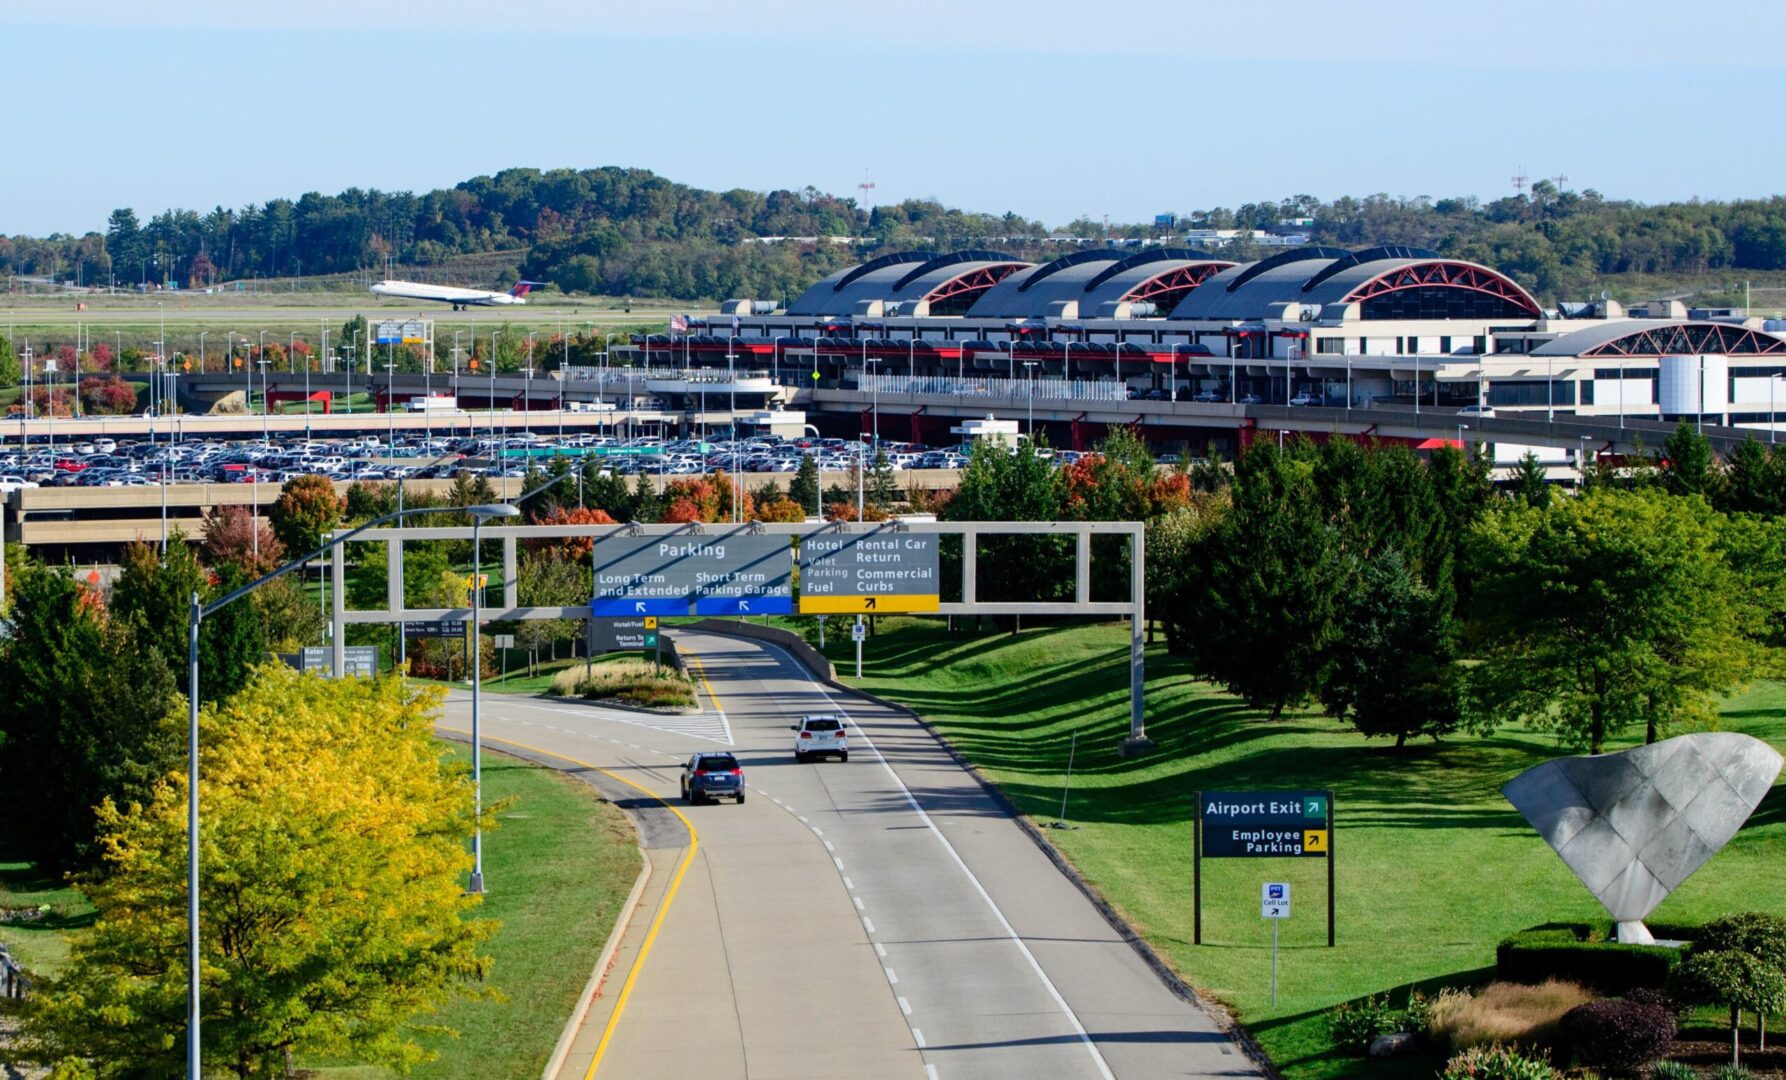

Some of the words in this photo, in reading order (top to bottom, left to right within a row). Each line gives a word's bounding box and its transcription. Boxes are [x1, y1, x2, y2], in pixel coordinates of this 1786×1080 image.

[807, 540, 843, 550] Hotel
[856, 539, 899, 550] Rental
[905, 539, 927, 549] Car
[660, 542, 725, 559] Parking
[808, 558, 836, 566] Valet
[856, 553, 901, 562] Return
[695, 572, 731, 582] Short
[733, 572, 765, 581] Term
[807, 568, 848, 578] Parking
[856, 567, 932, 579] Commercial
[599, 574, 630, 585] Long
[633, 573, 665, 583] Term
[600, 585, 624, 596] and
[627, 584, 689, 596] Extended
[695, 585, 742, 596] Parking
[744, 585, 789, 596] Garage
[807, 582, 833, 592] Fuel
[856, 581, 894, 591] Curbs
[1206, 801, 1265, 817] Airport
[1270, 801, 1302, 814] Exit
[1232, 829, 1301, 842] Employee
[1246, 842, 1302, 854] Parking
